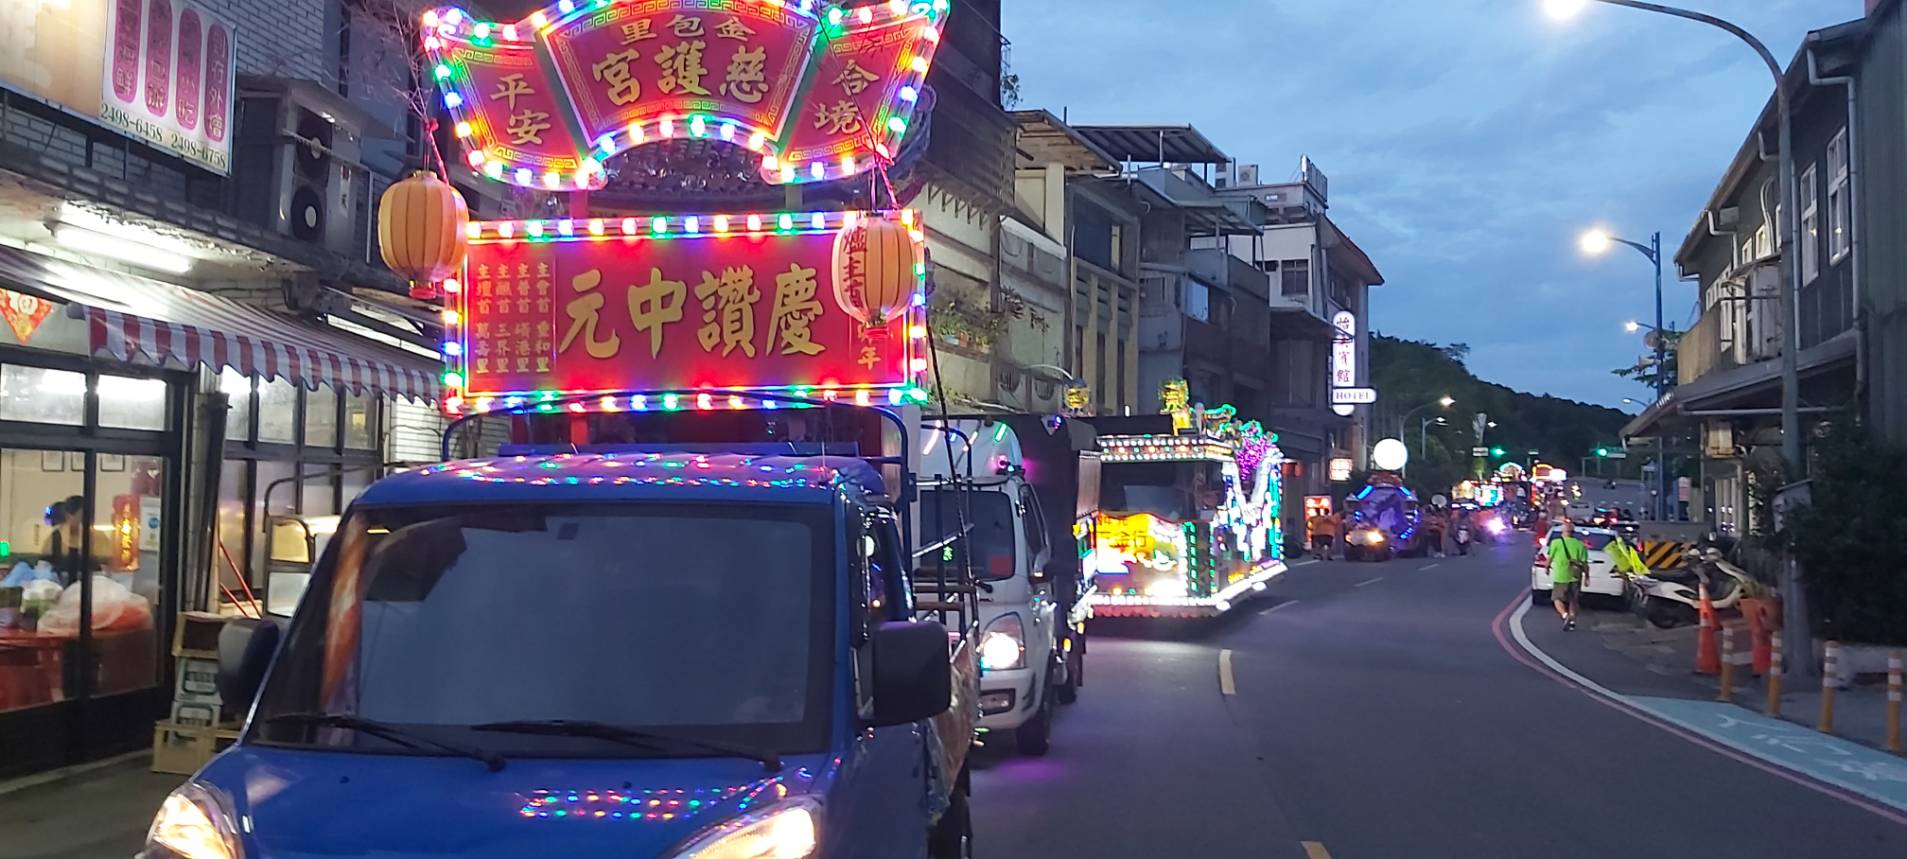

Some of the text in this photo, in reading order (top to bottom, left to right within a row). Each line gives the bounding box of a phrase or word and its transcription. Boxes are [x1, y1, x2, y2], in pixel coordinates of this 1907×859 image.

[619, 13, 756, 46] 金包里
[592, 40, 768, 105] 慈護宮
[812, 58, 880, 136] 合境
[101, 103, 226, 169] 2498-6458 2498-6758
[490, 72, 553, 145] 平安
[559, 262, 825, 360] 慶讚中元
[495, 322, 512, 374] 三界里
[1336, 391, 1369, 400] HOTEL
